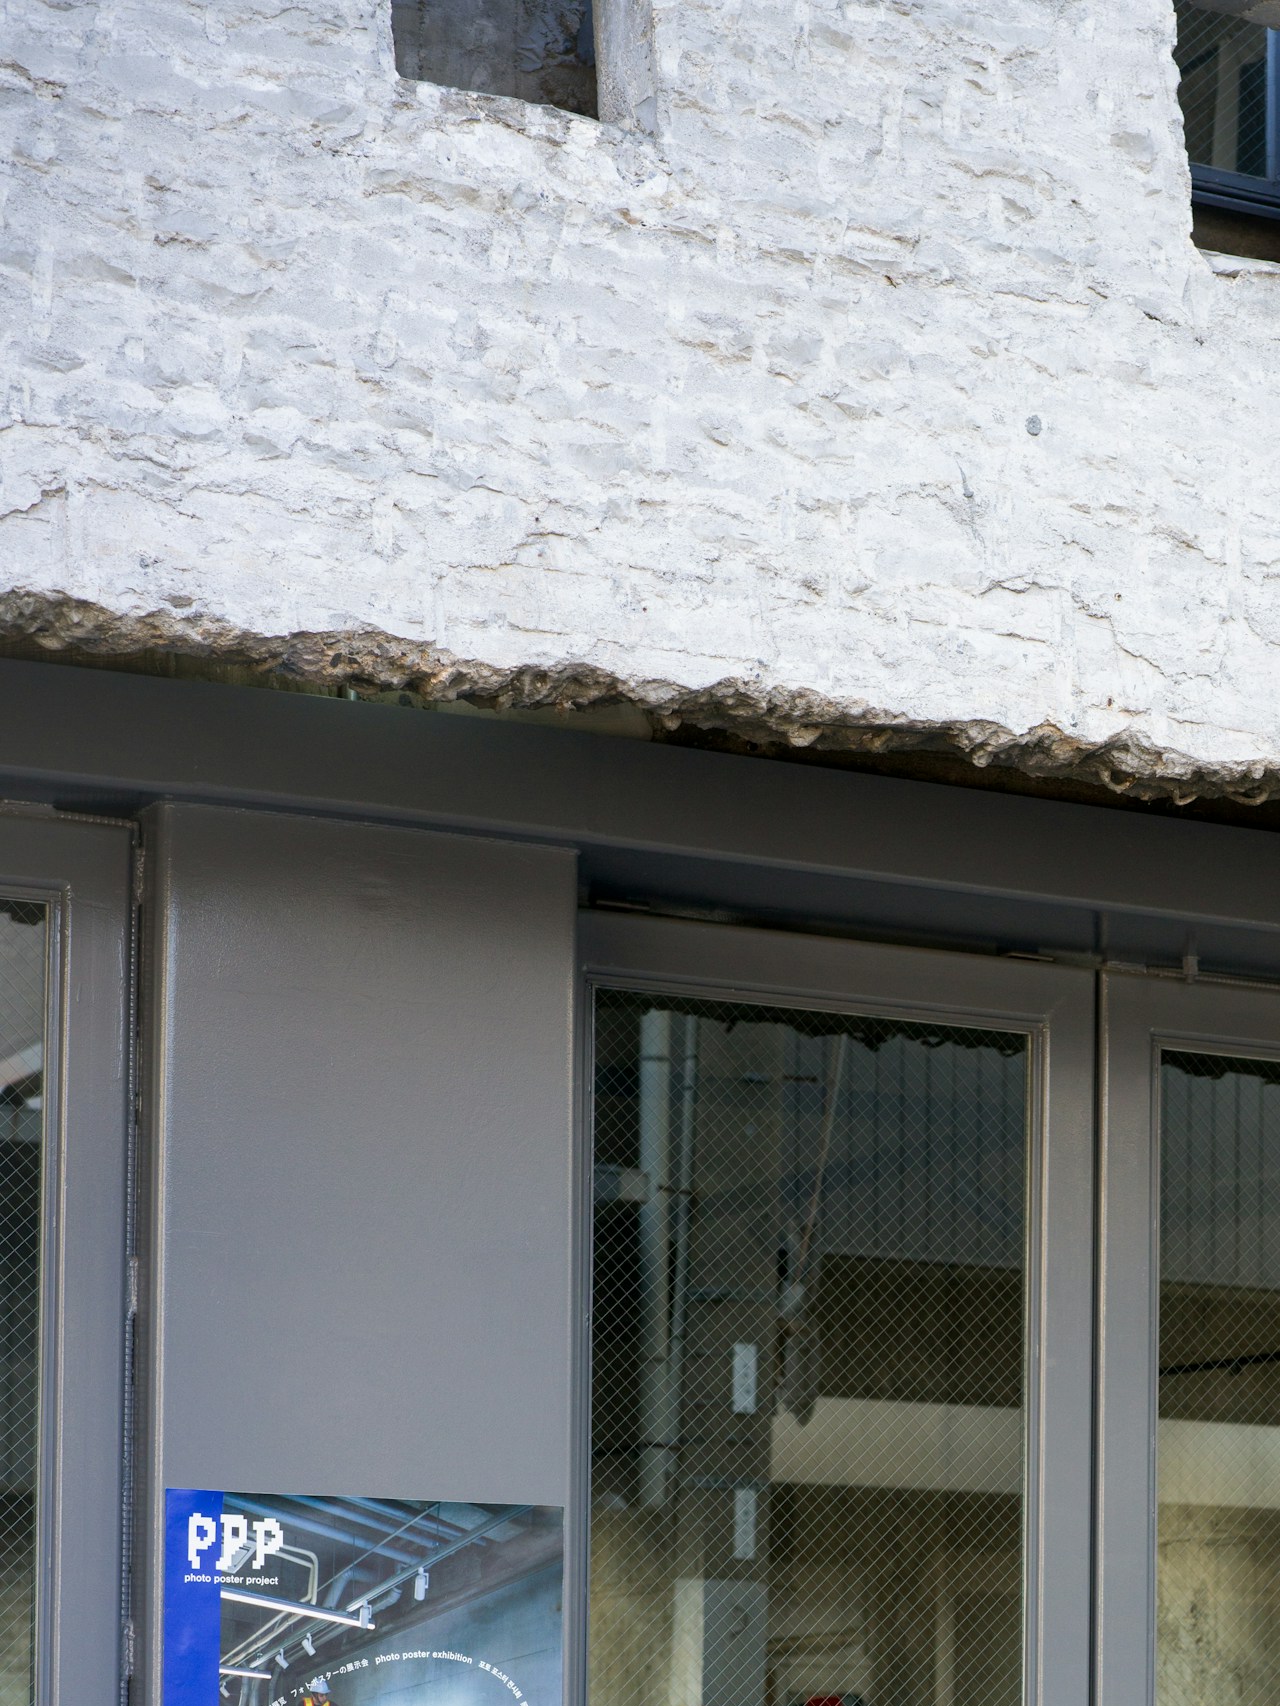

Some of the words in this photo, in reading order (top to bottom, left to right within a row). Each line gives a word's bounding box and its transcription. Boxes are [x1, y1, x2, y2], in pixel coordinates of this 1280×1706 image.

[184, 1573, 211, 1584] photo
[213, 1575, 244, 1585] poster
[246, 1576, 279, 1586] project
[375, 1653, 400, 1665] photo
[402, 1650, 430, 1660] poster
[432, 1651, 473, 1664] exhibition
